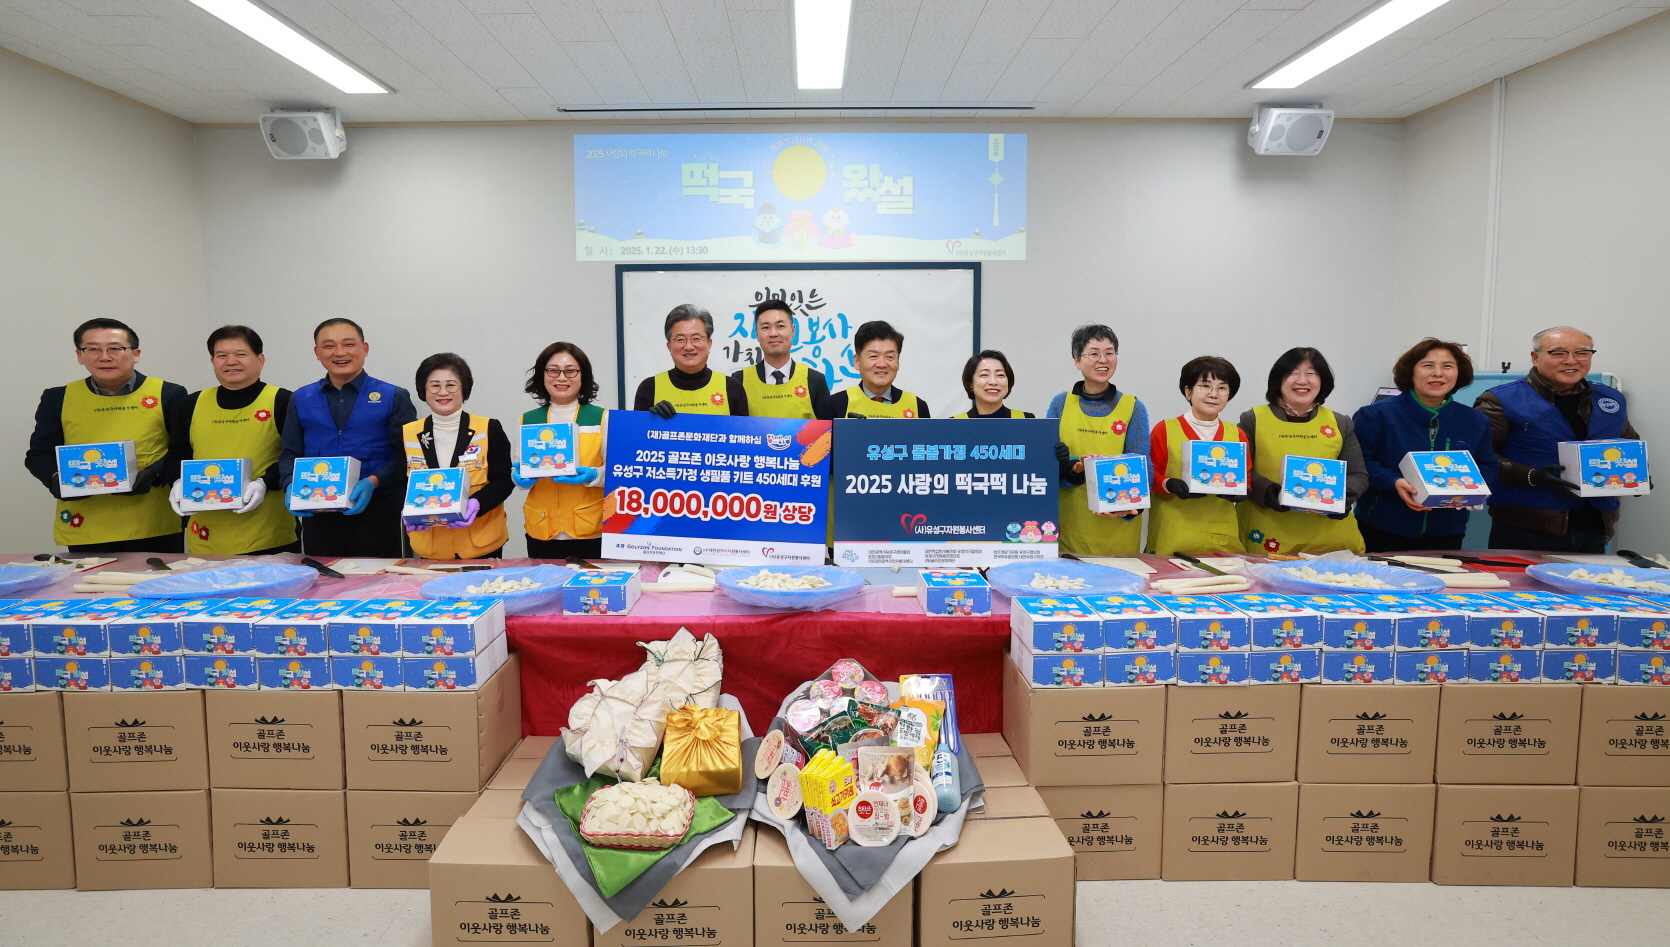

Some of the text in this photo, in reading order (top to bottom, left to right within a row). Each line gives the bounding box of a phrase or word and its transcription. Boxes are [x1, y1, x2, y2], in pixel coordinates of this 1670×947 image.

[586, 149, 668, 158] 2025 사랑의 떡국떡 나눔
[682, 163, 755, 209] 떡국
[584, 246, 592, 256] 일
[620, 246, 644, 256] 2025.
[646, 246, 653, 256] 1.
[655, 246, 668, 256] 22.
[669, 246, 684, 256] (수)
[686, 246, 708, 256] 13:30
[647, 430, 762, 445] (재)골프존문화재단과 함께하심
[866, 444, 1026, 460] 유성구 돌봄가정 450세대
[636, 450, 800, 470] 2025 골프존 이웃사랑 행복나눔
[612, 464, 822, 488] 유성구 저소득가정 생필품 키트 450세대 후원
[846, 473, 1048, 495] 2025 사랑의 떡국떡 나눔
[616, 489, 814, 522] 18,000,000원 상당
[914, 525, 986, 534] (사)유성구자원봉사센터
[257, 729, 285, 739] 골프존
[1083, 726, 1111, 736] 골프존
[1219, 724, 1247, 734] 골프존
[1356, 725, 1385, 735] 골프존
[1493, 725, 1522, 735] 골프존
[1635, 726, 1664, 736] 골프존
[117, 732, 146, 742] 골프존
[394, 731, 423, 741] 골프존
[1058, 739, 1135, 750] 이웃사랑 행복나눔
[1194, 736, 1270, 747] 이웃사랑 행복나눔
[1331, 738, 1408, 748] 이웃사랑 행복나눔
[1467, 738, 1546, 748] 이웃사랑 행복나눔
[1609, 739, 1647, 749] 이웃사랑
[0, 745, 32, 755] 복나눔
[93, 745, 173, 756] 이웃사랑 행복나눔
[233, 742, 310, 753] 이웃사랑 행복나눔
[371, 744, 448, 755] 이웃사랑 행복나눔
[858, 806, 872, 814] 햇반
[1082, 823, 1109, 833] 골프존
[1217, 823, 1245, 833] 골프존
[1351, 823, 1379, 833] 골프존
[1491, 827, 1520, 837] 골프존
[1634, 828, 1663, 838] 골프존
[122, 831, 151, 841] 골프존
[262, 830, 290, 840] 골프존
[399, 831, 427, 841] 골프존
[1068, 835, 1133, 846] 웃사랑 행복나눔
[1192, 836, 1268, 846] 이웃사랑 행복나눔
[1326, 836, 1403, 846] 이웃사랑 행복나눔
[1465, 840, 1544, 850] 이웃사랑 행복나눔
[1, 845, 39, 855] 행복나눔
[99, 843, 177, 854] 이웃사랑 행복나눔
[238, 842, 315, 853] 이웃사랑 행복나눔
[375, 844, 436, 853] 이웃사랑 행복
[1608, 841, 1646, 851] 이웃사랑
[488, 908, 521, 920] 골프존
[814, 909, 837, 920] 골프
[981, 904, 1013, 916] 골프존
[654, 914, 687, 925] 골프존
[953, 917, 1041, 931] 이웃사랑 행복나눔
[460, 923, 550, 935] 이웃사랑 행복나눔
[625, 927, 717, 940] 이웃사랑 행복나눔
[786, 923, 830, 934] 이웃사랑
